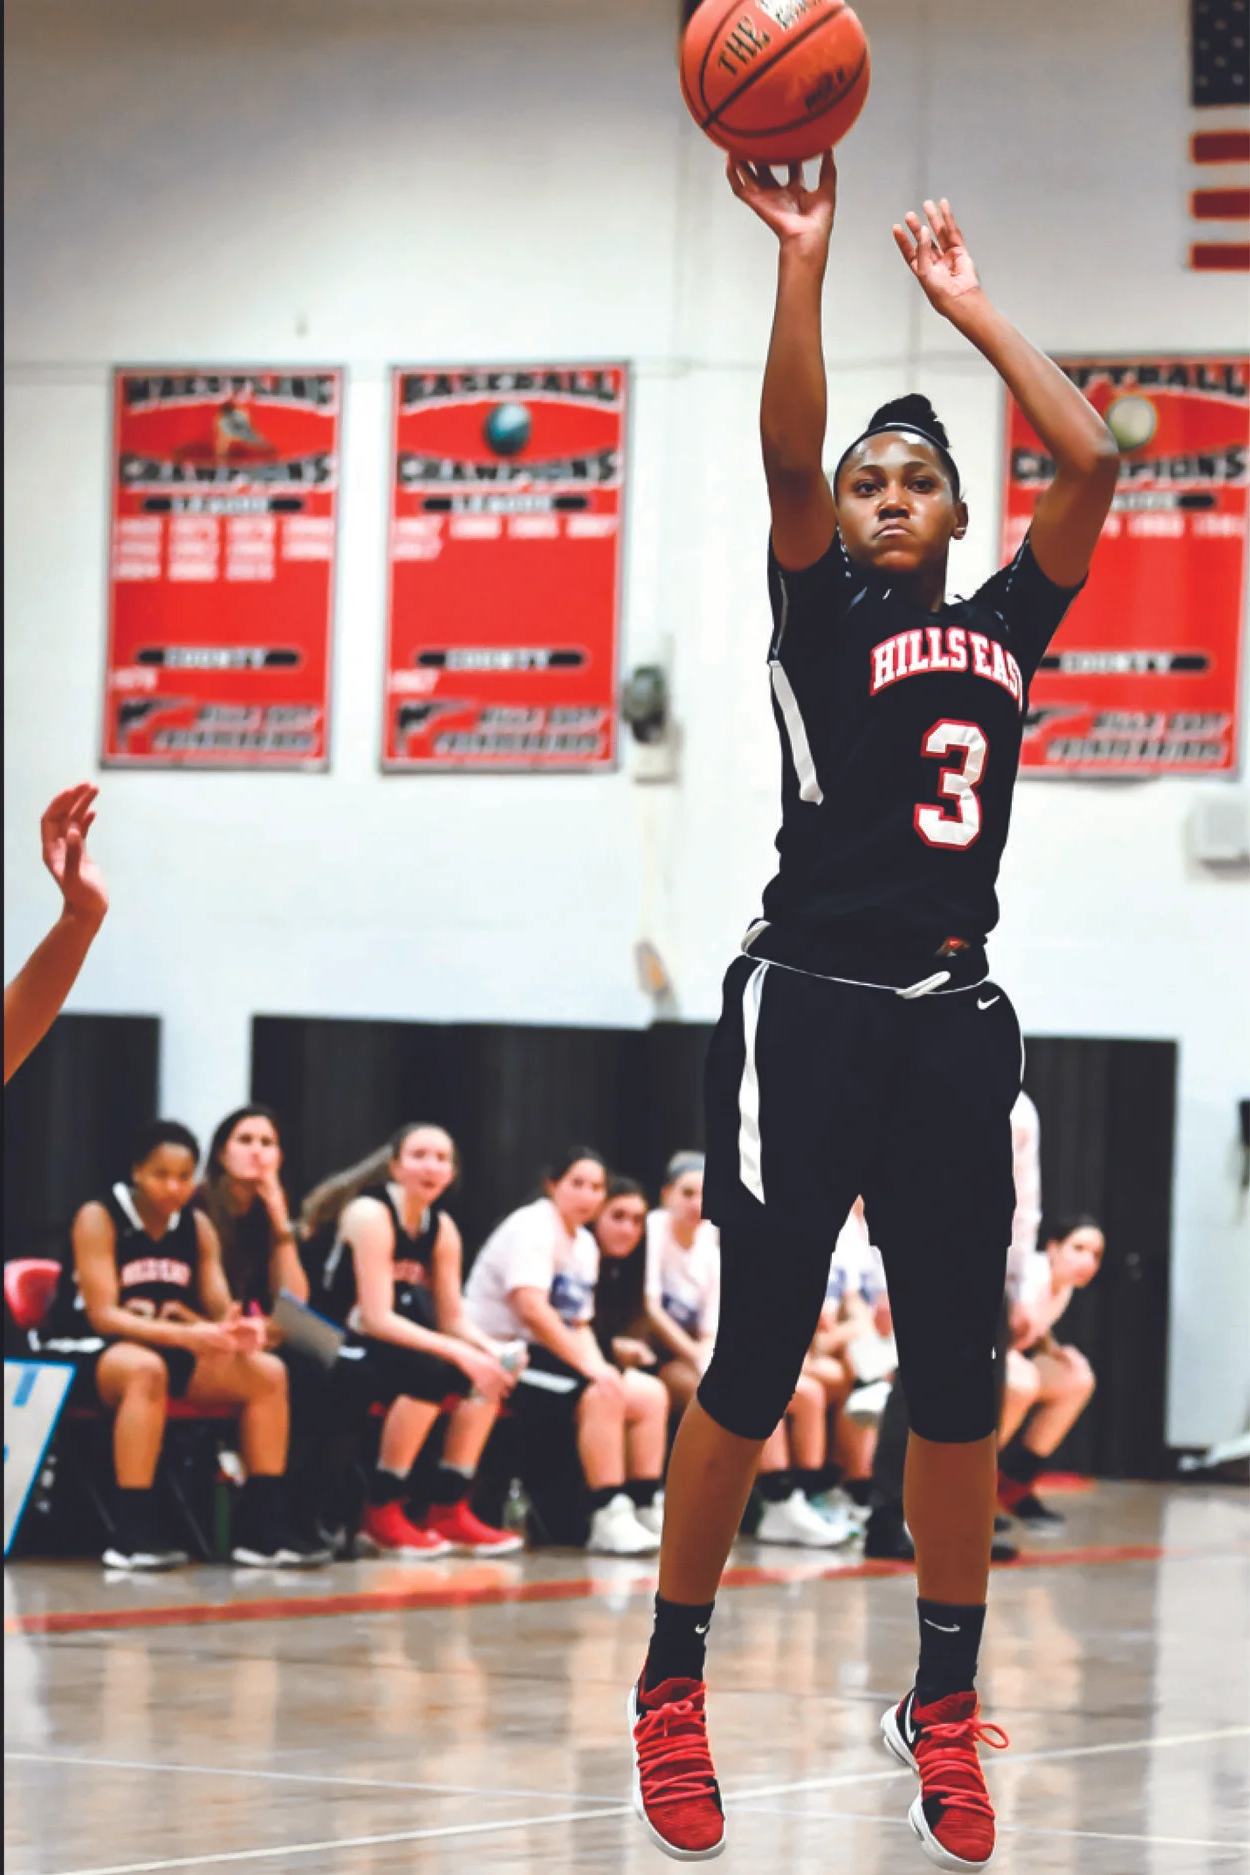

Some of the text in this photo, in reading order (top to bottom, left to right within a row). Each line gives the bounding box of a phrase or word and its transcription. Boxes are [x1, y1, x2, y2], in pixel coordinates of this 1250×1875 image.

[718, 16, 772, 77] THE
[870, 626, 968, 696] HILLS
[913, 718, 990, 851] 3
